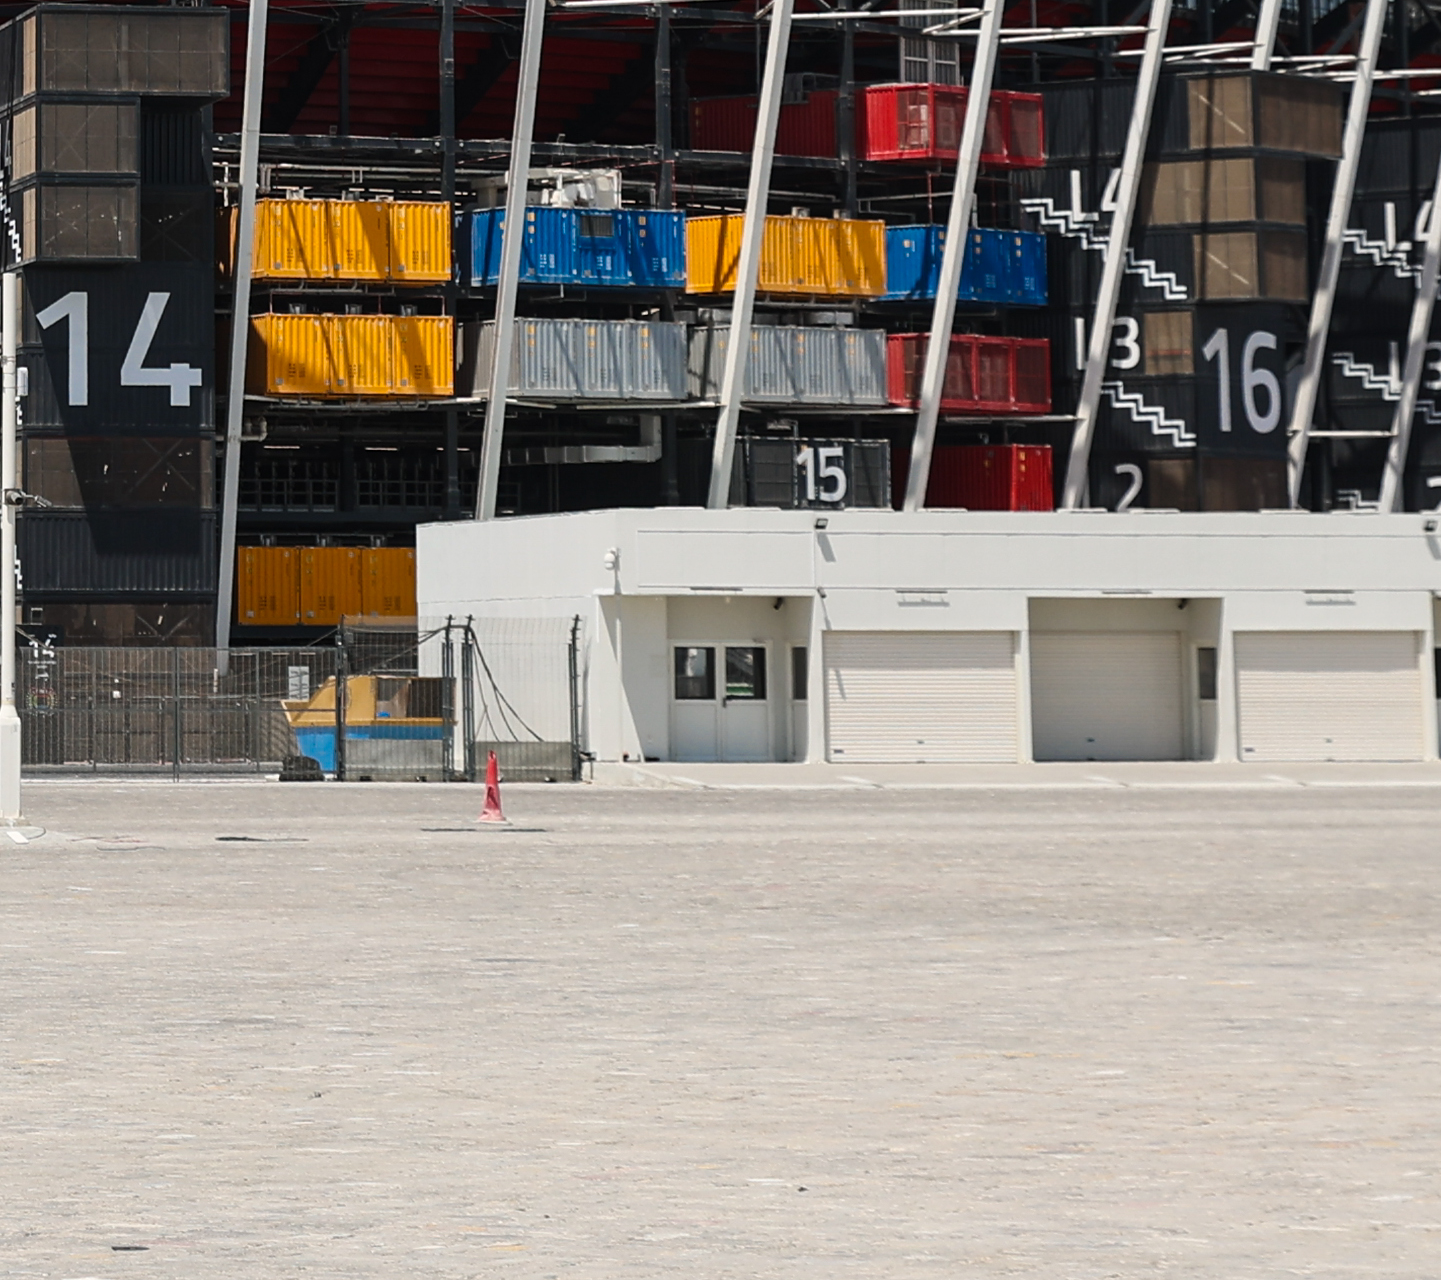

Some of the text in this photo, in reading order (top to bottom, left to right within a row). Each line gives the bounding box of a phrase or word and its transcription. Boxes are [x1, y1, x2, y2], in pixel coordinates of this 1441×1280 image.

[35, 291, 203, 407] 14
[1201, 328, 1282, 434] 16
[796, 446, 847, 502] 15
